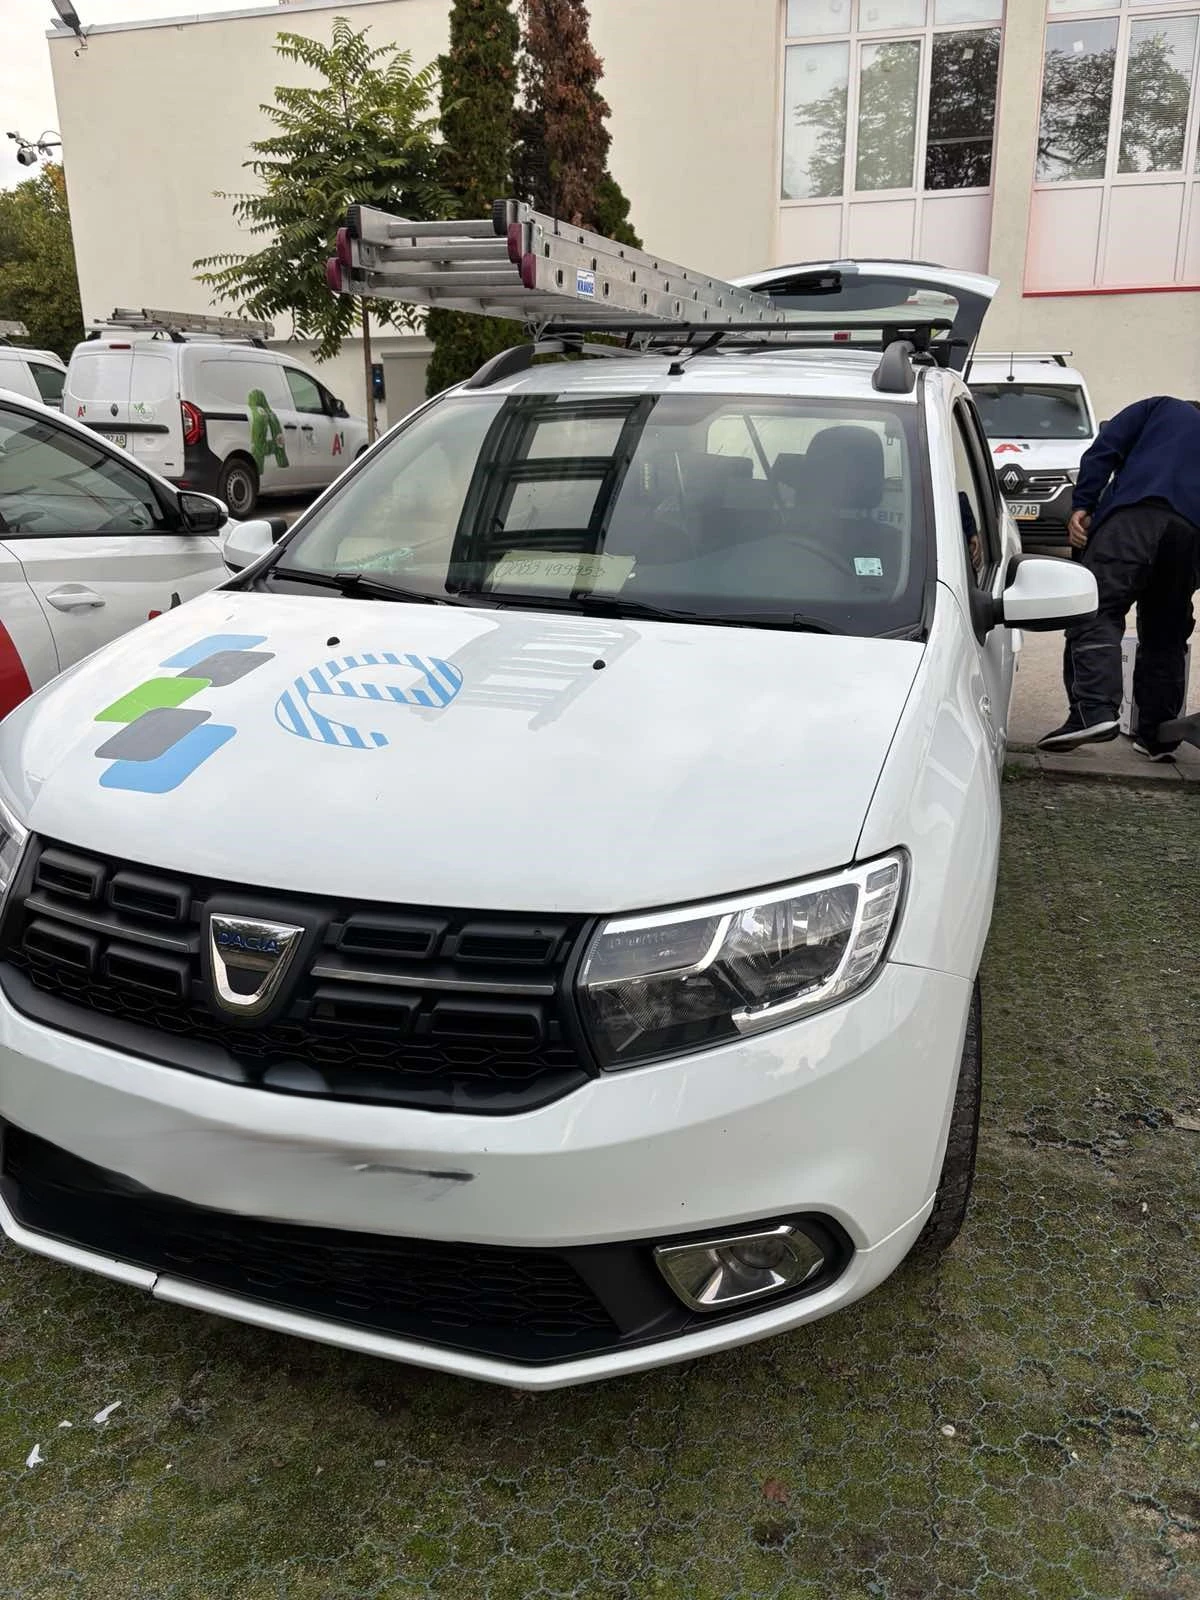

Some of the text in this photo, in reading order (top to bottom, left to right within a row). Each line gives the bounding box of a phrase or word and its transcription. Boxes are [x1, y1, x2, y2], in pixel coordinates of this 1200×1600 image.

[77, 404, 86, 417] A1
[331, 431, 344, 456] A1
[993, 443, 1030, 453] A1
[1024, 505, 1038, 516] AB
[218, 931, 280, 953] DACIA
